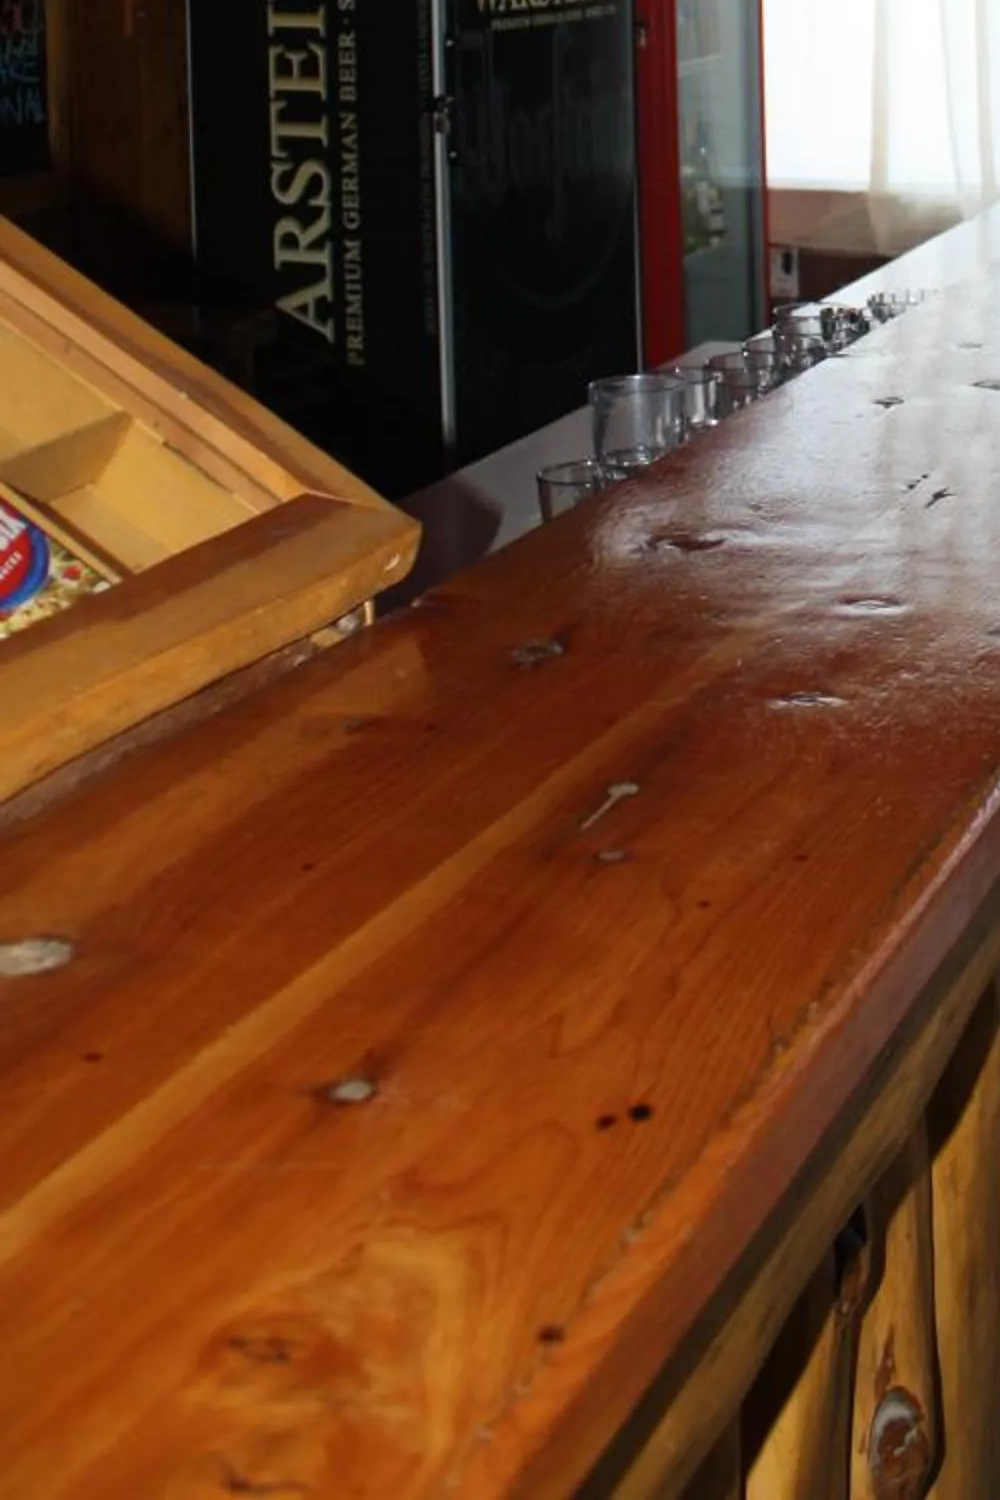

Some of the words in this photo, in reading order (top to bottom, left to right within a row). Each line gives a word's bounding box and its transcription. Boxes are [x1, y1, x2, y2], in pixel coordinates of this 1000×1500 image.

[338, 30, 358, 102] BEER
[339, 111, 360, 229] GERMAN
[343, 238, 365, 366] PREMIUM
